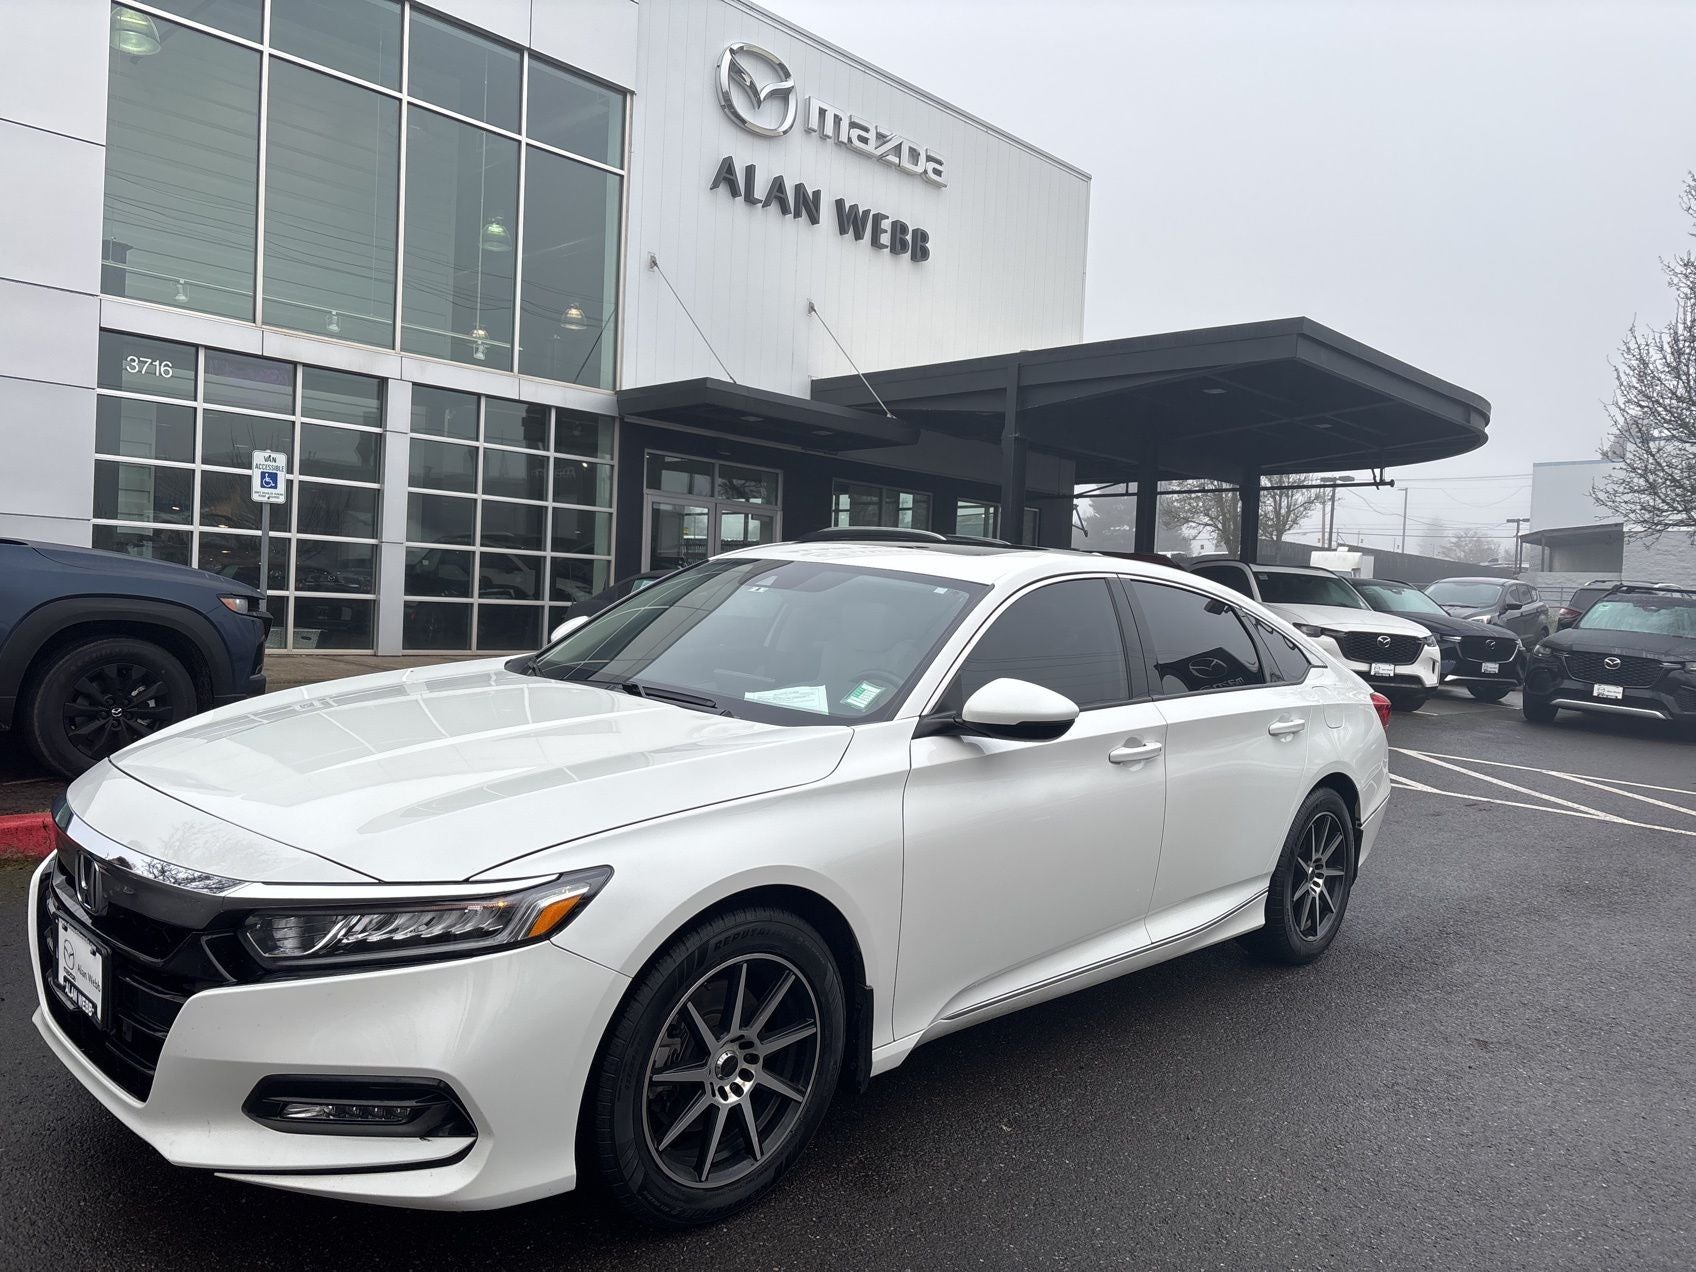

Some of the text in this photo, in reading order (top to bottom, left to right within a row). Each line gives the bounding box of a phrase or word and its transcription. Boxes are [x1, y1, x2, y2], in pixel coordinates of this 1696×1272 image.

[709, 155, 930, 262] ALAN WEBB
[126, 355, 173, 378] 3716
[263, 454, 277, 463] VAN
[255, 463, 285, 472] ACCESSIBLE
